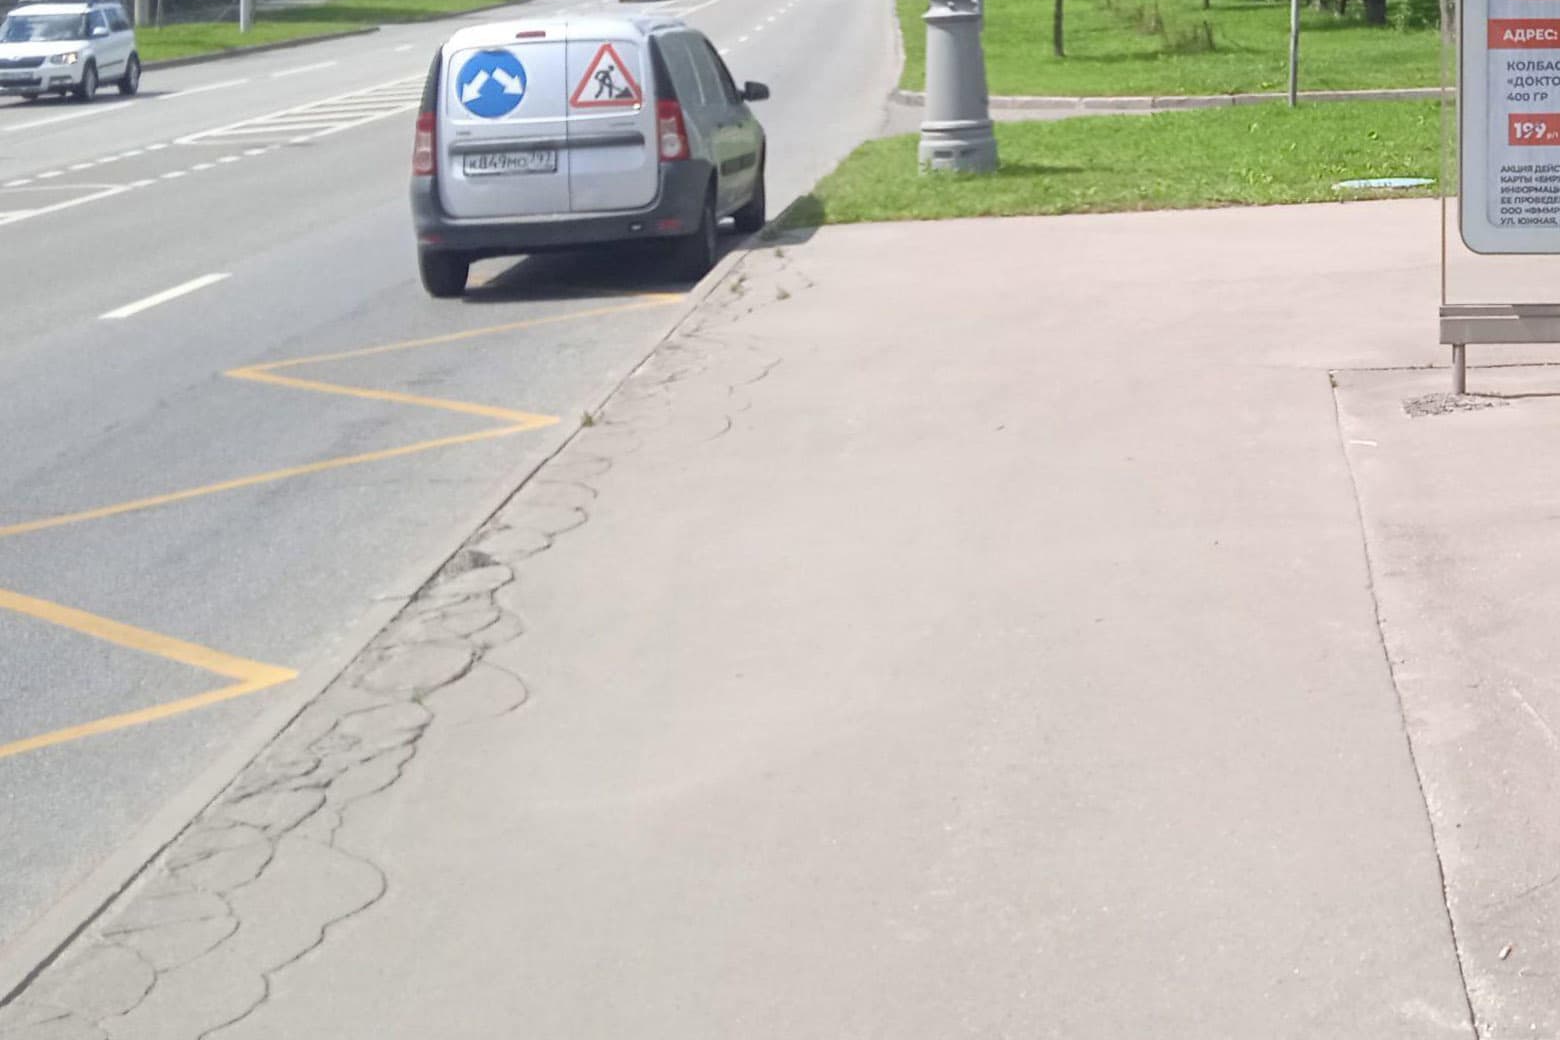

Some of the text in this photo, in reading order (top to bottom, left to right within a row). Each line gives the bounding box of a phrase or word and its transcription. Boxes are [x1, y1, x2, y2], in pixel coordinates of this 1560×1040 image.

[1503, 28, 1558, 42] АДРЕС:
[1506, 92, 1549, 102] 400 ГР
[1500, 175, 1533, 183] КАРТЫ
